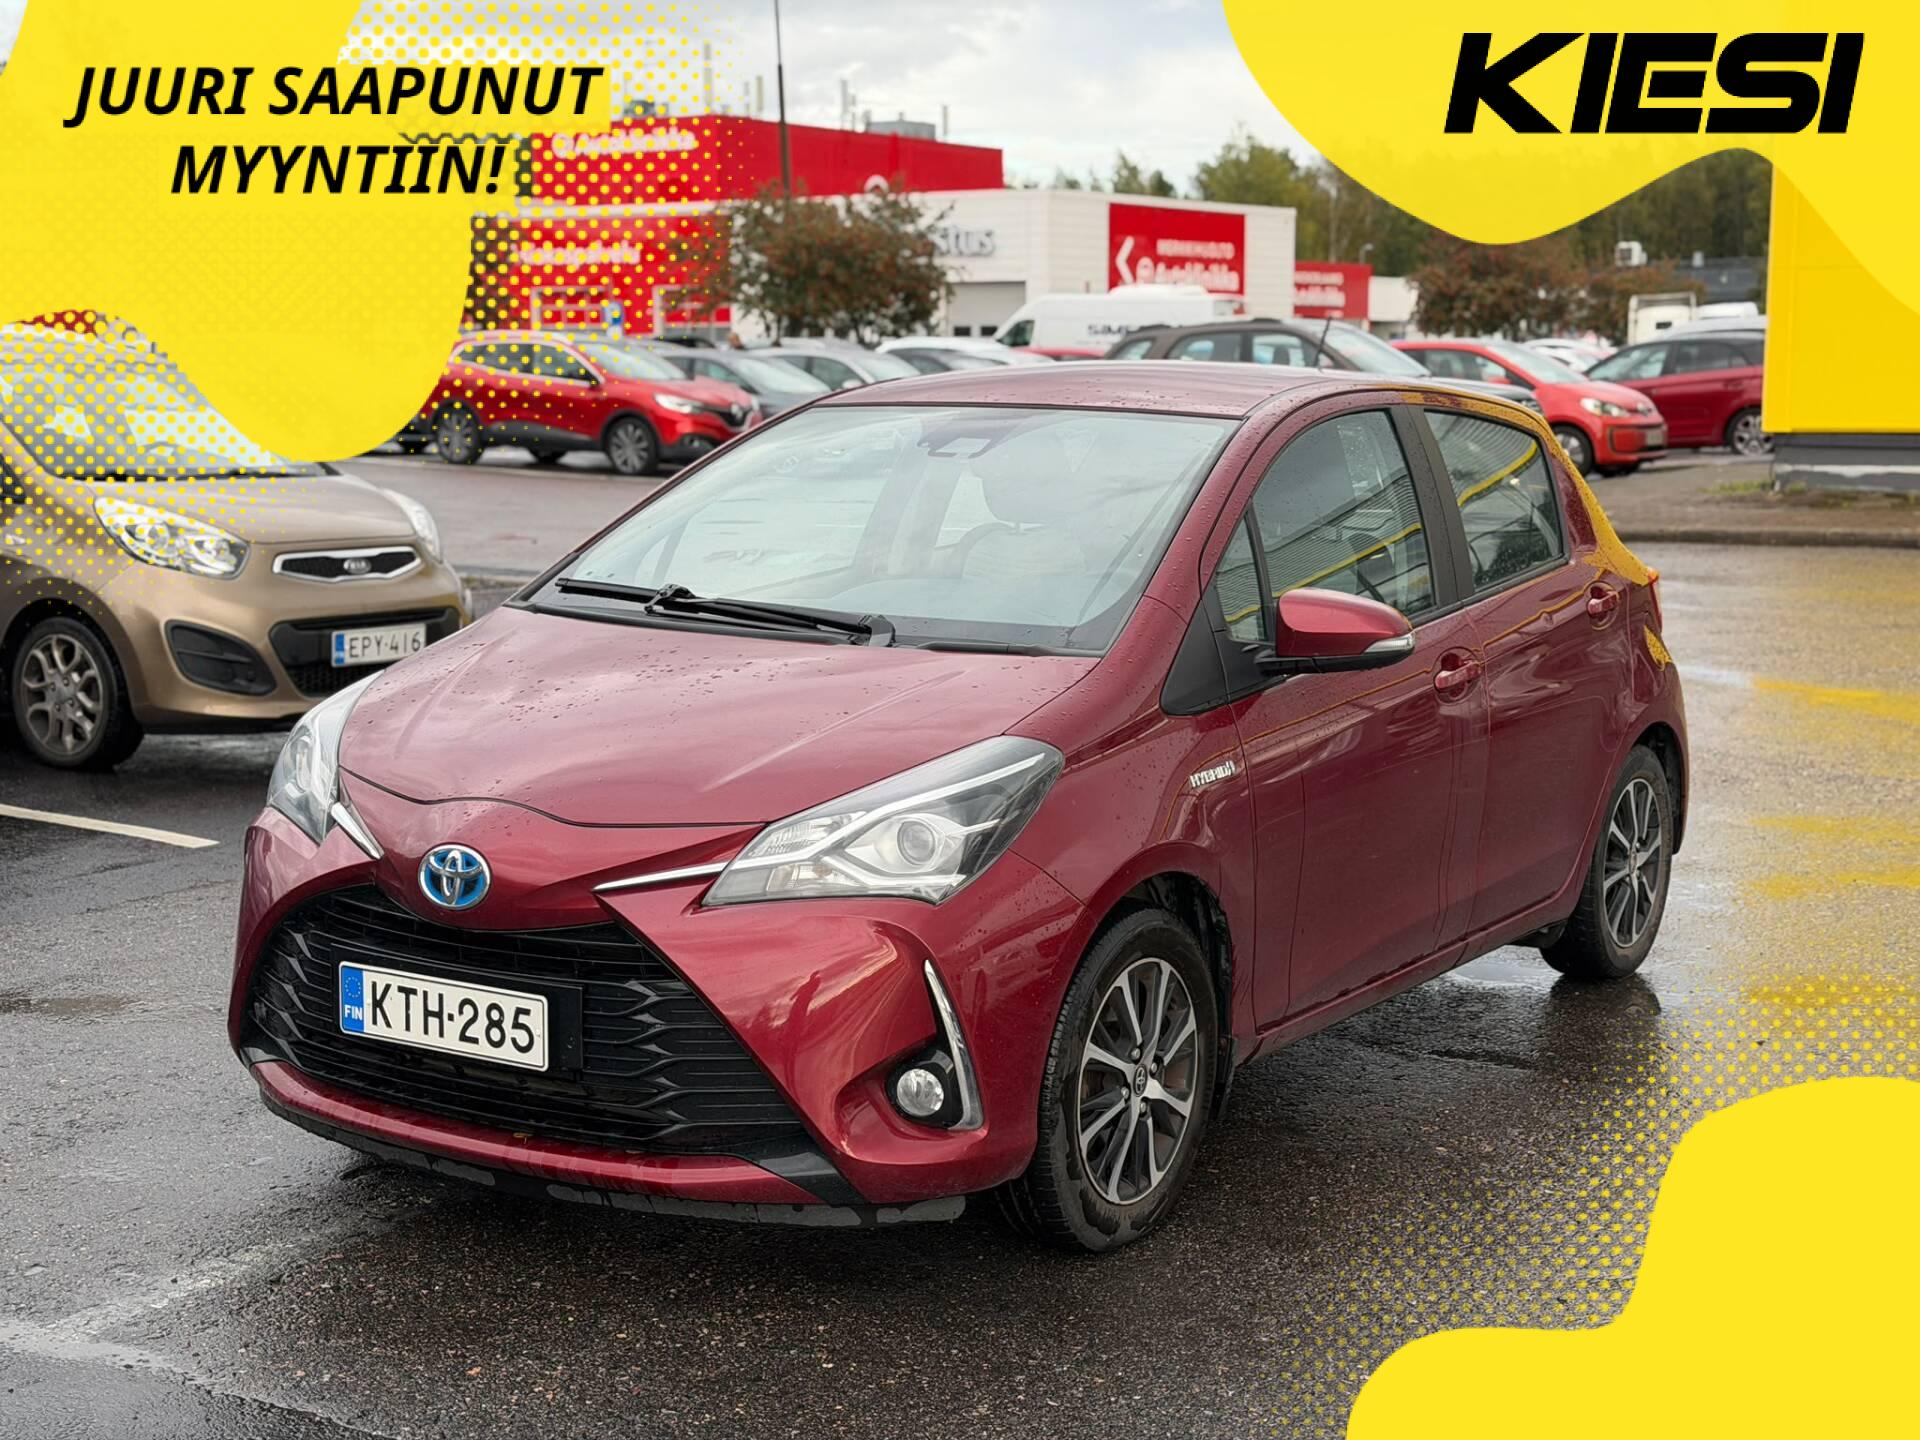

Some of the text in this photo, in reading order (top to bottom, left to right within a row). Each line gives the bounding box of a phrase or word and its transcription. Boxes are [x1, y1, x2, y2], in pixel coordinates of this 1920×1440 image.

[349, 631, 421, 658] EPY-416
[344, 981, 534, 1054] FIN KTH-285
